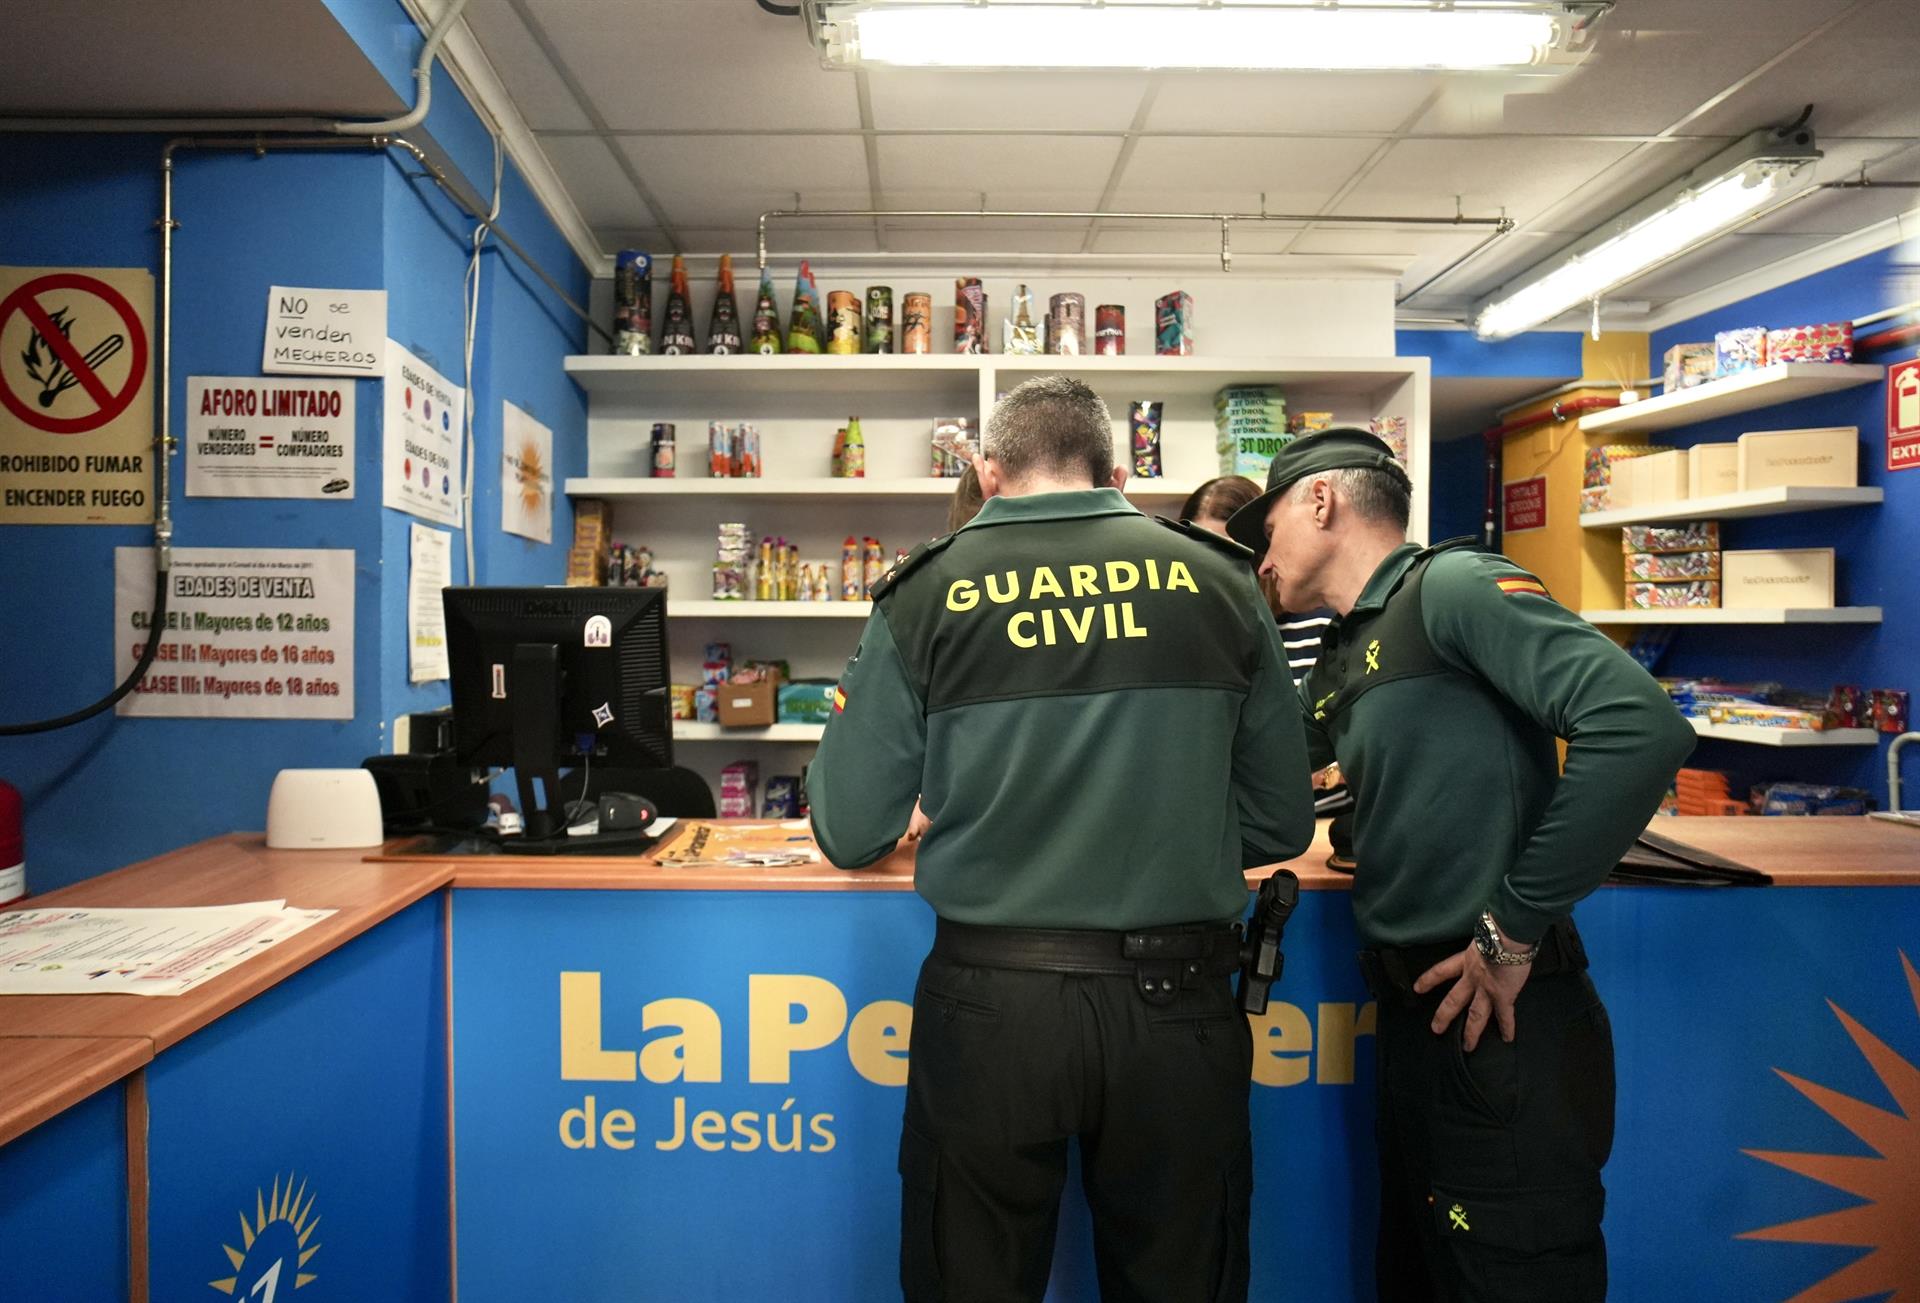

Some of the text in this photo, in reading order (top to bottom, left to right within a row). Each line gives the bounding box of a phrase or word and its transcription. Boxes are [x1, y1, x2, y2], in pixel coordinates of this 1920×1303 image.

[280, 297, 350, 314] NO se
[276, 324, 352, 344] venden
[274, 347, 376, 363] MECHEROS
[200, 389, 341, 417] AFORO LIMITADO
[208, 426, 246, 441] NÚMERO
[291, 428, 329, 443] NÚMERO
[197, 443, 256, 456] VENDEDORES
[277, 444, 343, 458] COMPRADORES
[1240, 437, 1254, 454] 3T
[1892, 443, 1920, 460] EXT
[0, 455, 143, 473] ROHIBIDO FUMAR
[5, 489, 145, 507] ENCENDER FUEGO
[174, 575, 315, 599] EDADES DE VENTA
[946, 559, 1200, 612] GUARDIA
[131, 611, 177, 630] CLE
[194, 612, 251, 635] Mayores
[256, 613, 273, 631] de
[277, 613, 294, 631] 12
[297, 613, 330, 632] años
[1007, 602, 1148, 649] CIVIL
[132, 643, 178, 662] CSE
[200, 644, 257, 667] Mayores
[260, 645, 278, 664] de
[282, 645, 299, 665] 16
[301, 646, 335, 665] años
[204, 677, 261, 699] Mayores
[264, 678, 282, 698] de
[286, 677, 303, 697] 18
[306, 678, 340, 698] años
[560, 971, 722, 1084] La
[559, 1095, 836, 1153] de Jesús
